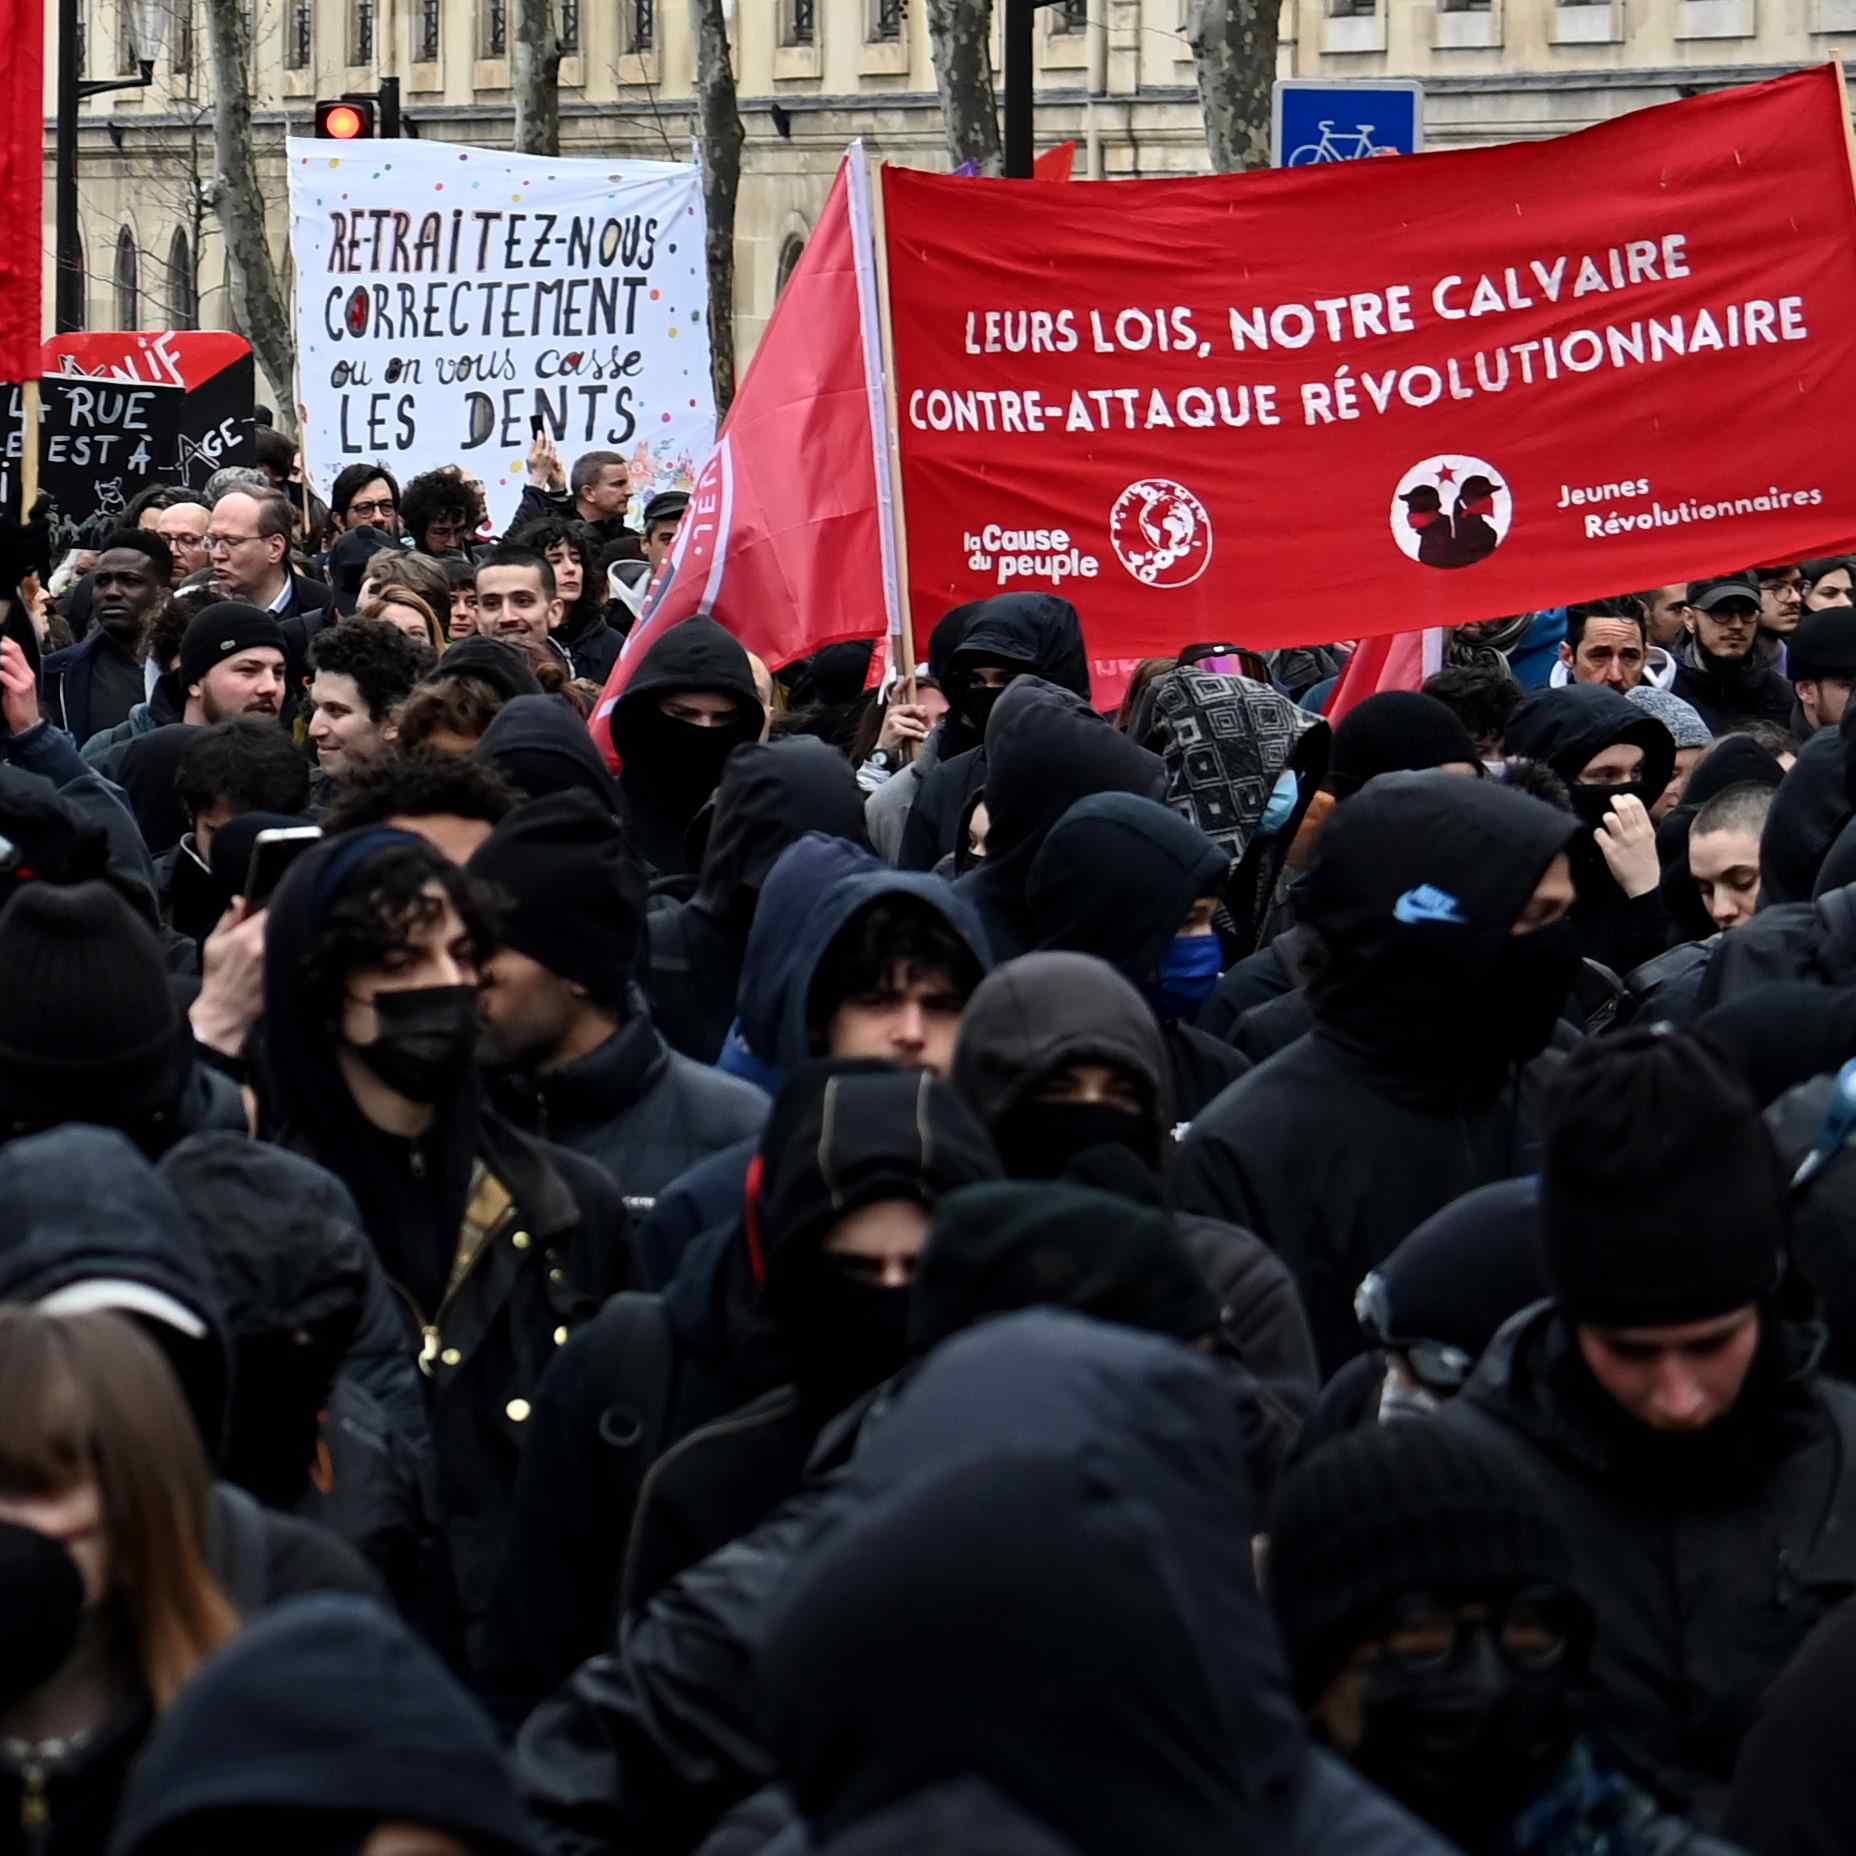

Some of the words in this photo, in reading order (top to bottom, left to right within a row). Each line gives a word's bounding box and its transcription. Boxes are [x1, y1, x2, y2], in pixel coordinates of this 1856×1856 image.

[324, 276, 648, 342] CORRECTEMENT
[964, 308, 1079, 355] LEURS
[1089, 305, 1211, 358] LOIS,
[1228, 284, 1415, 352] NOTRE
[1431, 233, 1691, 322] CALVAIRE
[330, 359, 373, 389] ou
[384, 356, 424, 385] on
[435, 347, 517, 385] vous
[534, 344, 644, 379] casse
[908, 384, 1281, 433] CONTRE-ATTAQUE
[1299, 295, 1809, 426] RÉVOLUTIONNAIRE
[63, 386, 156, 429] RUE
[339, 392, 416, 454] LES
[459, 384, 637, 451] DENTS
[47, 433, 123, 466] EST
[127, 433, 153, 476] À
[1556, 477, 1650, 508] Jeunes
[1584, 486, 1823, 539] Révolutionnaires
[963, 531, 981, 553] la
[982, 523, 1071, 552] Cause
[968, 550, 992, 571] du
[997, 547, 1100, 585] peuple
